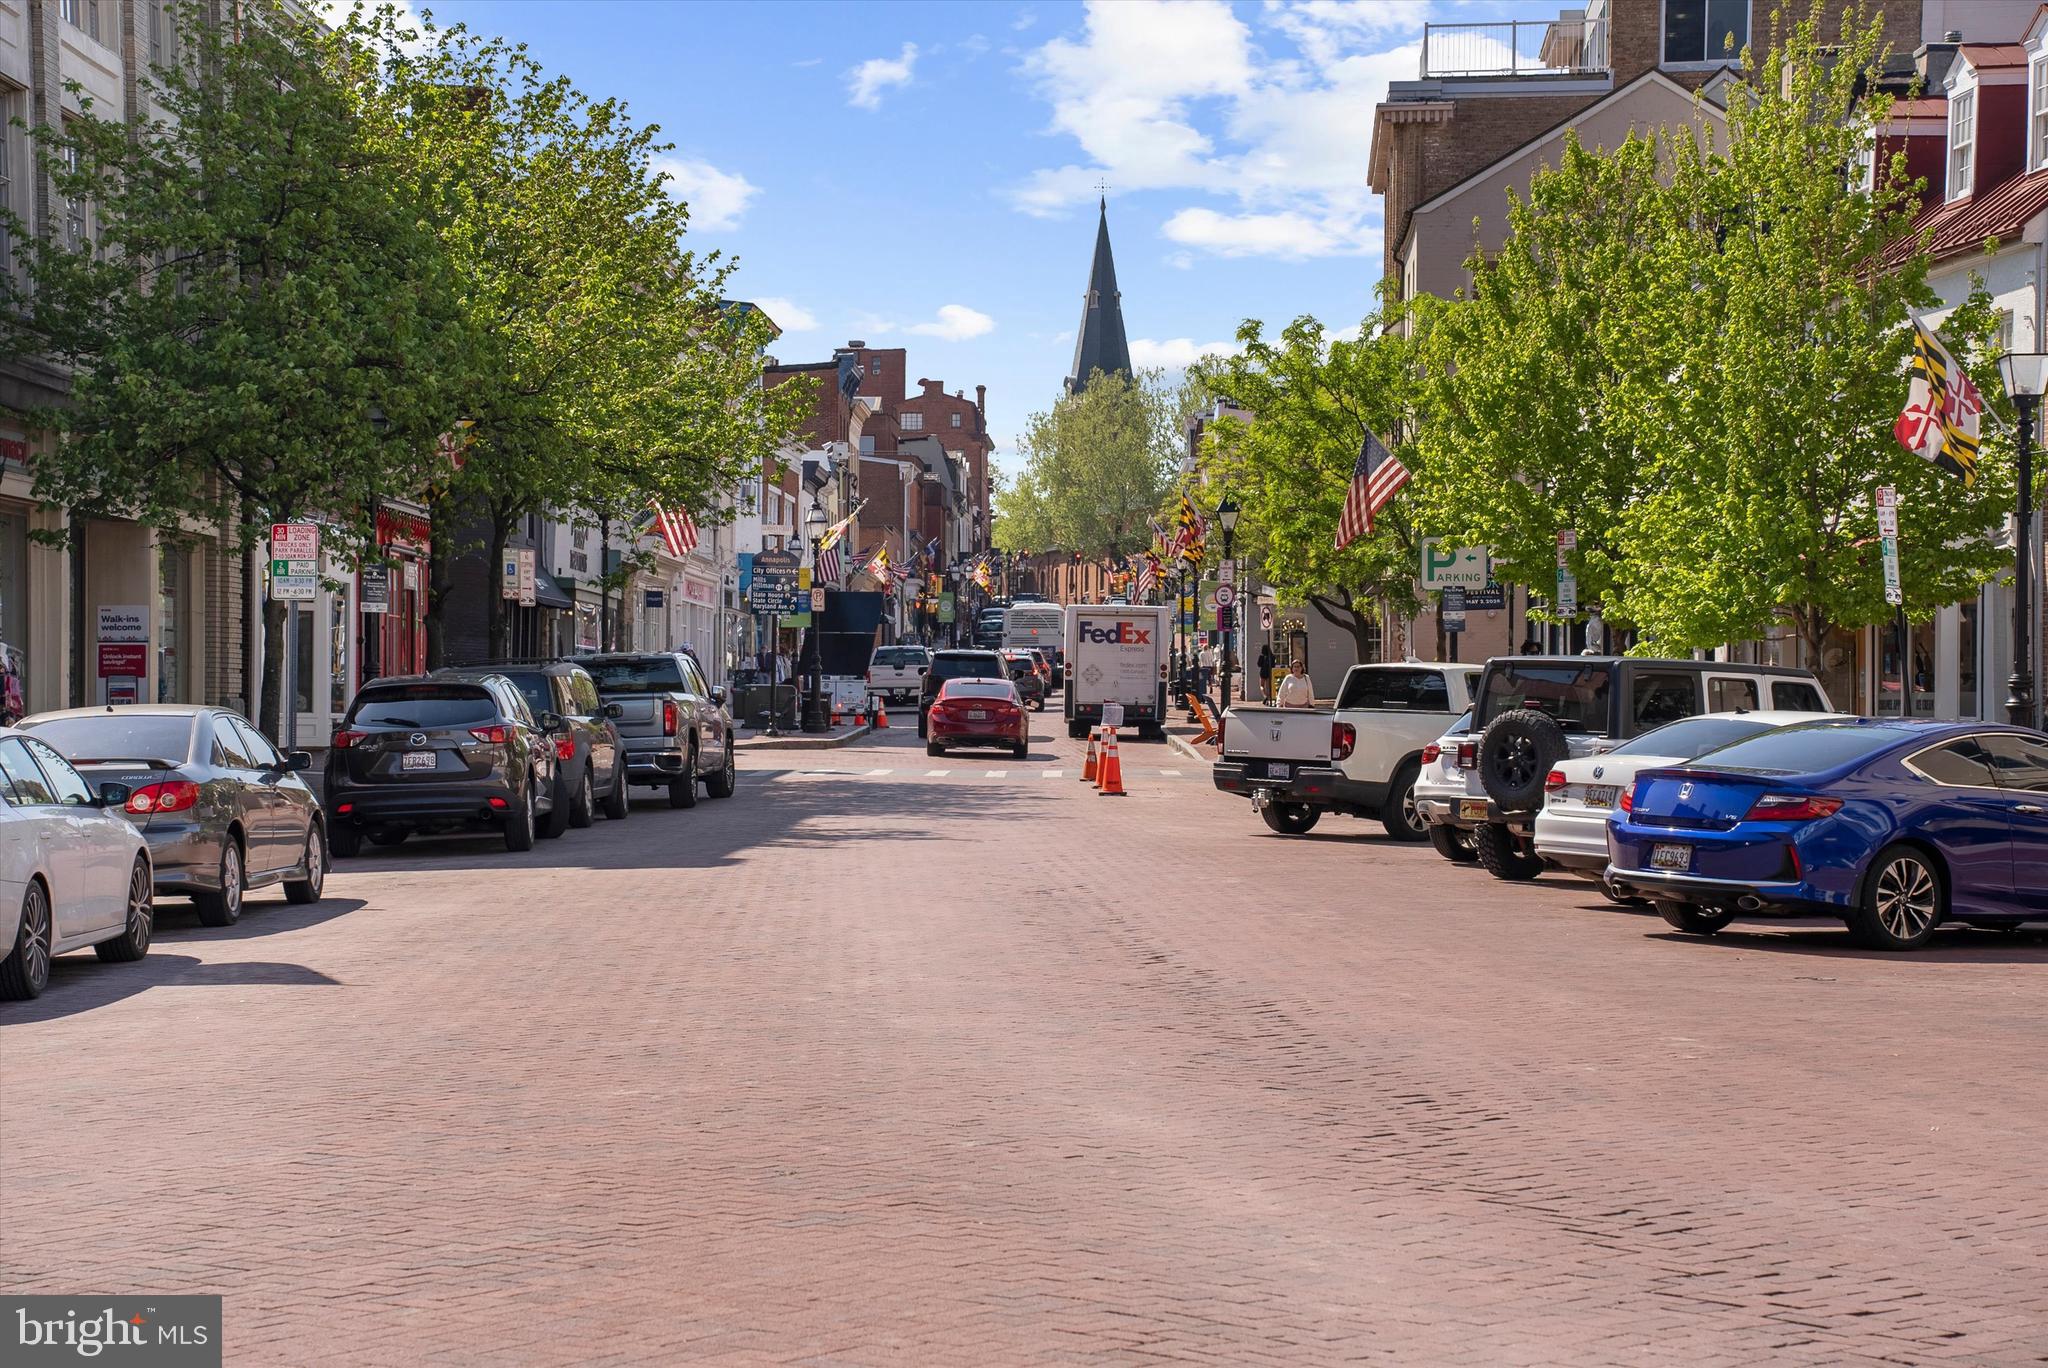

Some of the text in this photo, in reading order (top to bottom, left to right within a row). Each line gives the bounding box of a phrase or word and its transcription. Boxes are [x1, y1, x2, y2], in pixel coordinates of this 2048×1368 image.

[275, 533, 287, 541] MIN
[760, 556, 791, 564] Annapolis
[1427, 543, 1481, 583] PARKING
[752, 567, 764, 575] City
[101, 615, 140, 623] Walk-ins
[101, 623, 142, 631] welcome
[1079, 621, 1151, 644] FedEx
